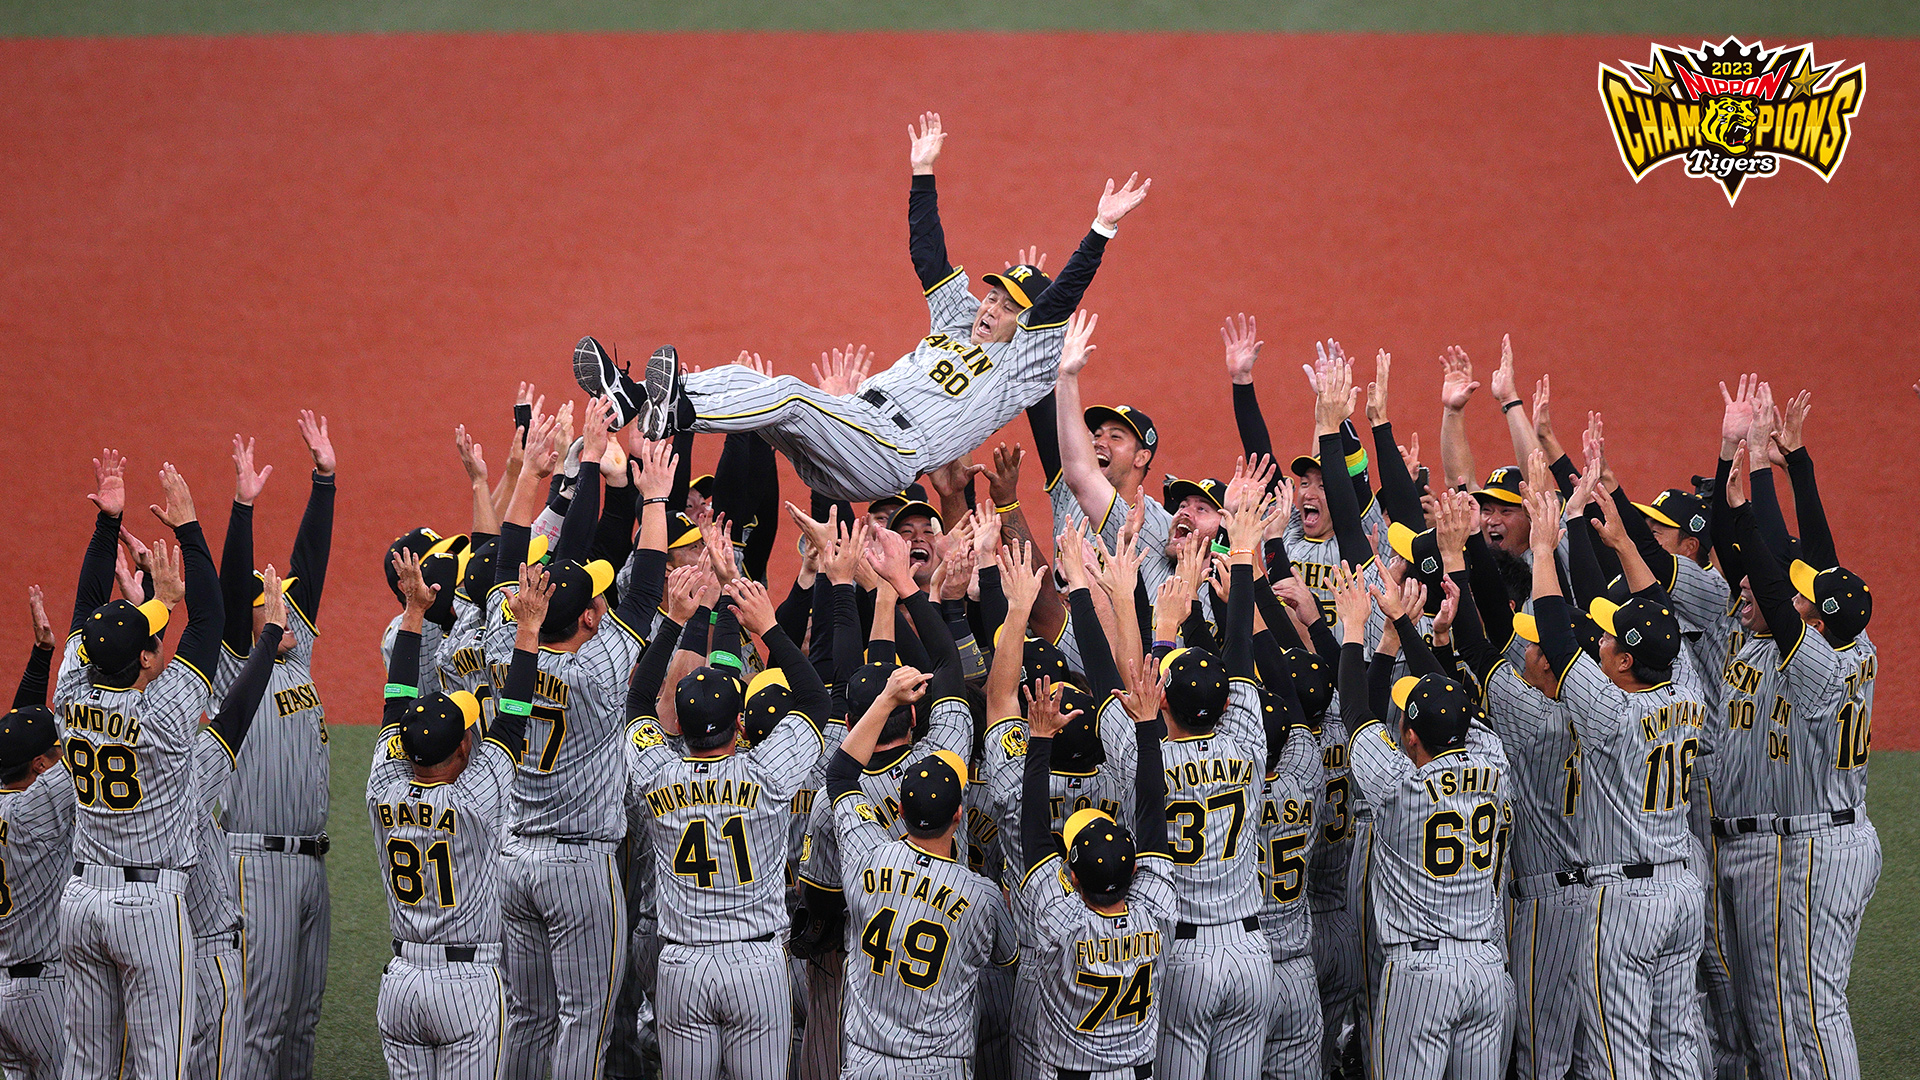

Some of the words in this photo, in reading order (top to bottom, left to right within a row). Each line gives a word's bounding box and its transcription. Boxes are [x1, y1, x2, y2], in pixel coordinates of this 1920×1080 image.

[928, 358, 970, 397] 80
[65, 702, 141, 746] ANDOH
[66, 737, 144, 812] 88
[645, 779, 761, 819] MURAKAMI
[1424, 767, 1500, 804] ISHII
[1642, 737, 1699, 813] 116
[378, 802, 457, 836] BABA
[673, 815, 755, 889] 41
[1165, 788, 1247, 866] 37
[1423, 801, 1498, 879] 69
[386, 837, 457, 909] 81
[862, 867, 971, 923] OHTAKE
[861, 905, 952, 992] 49
[1075, 929, 1162, 967] FUJIMOTO
[1075, 962, 1154, 1033] 74
